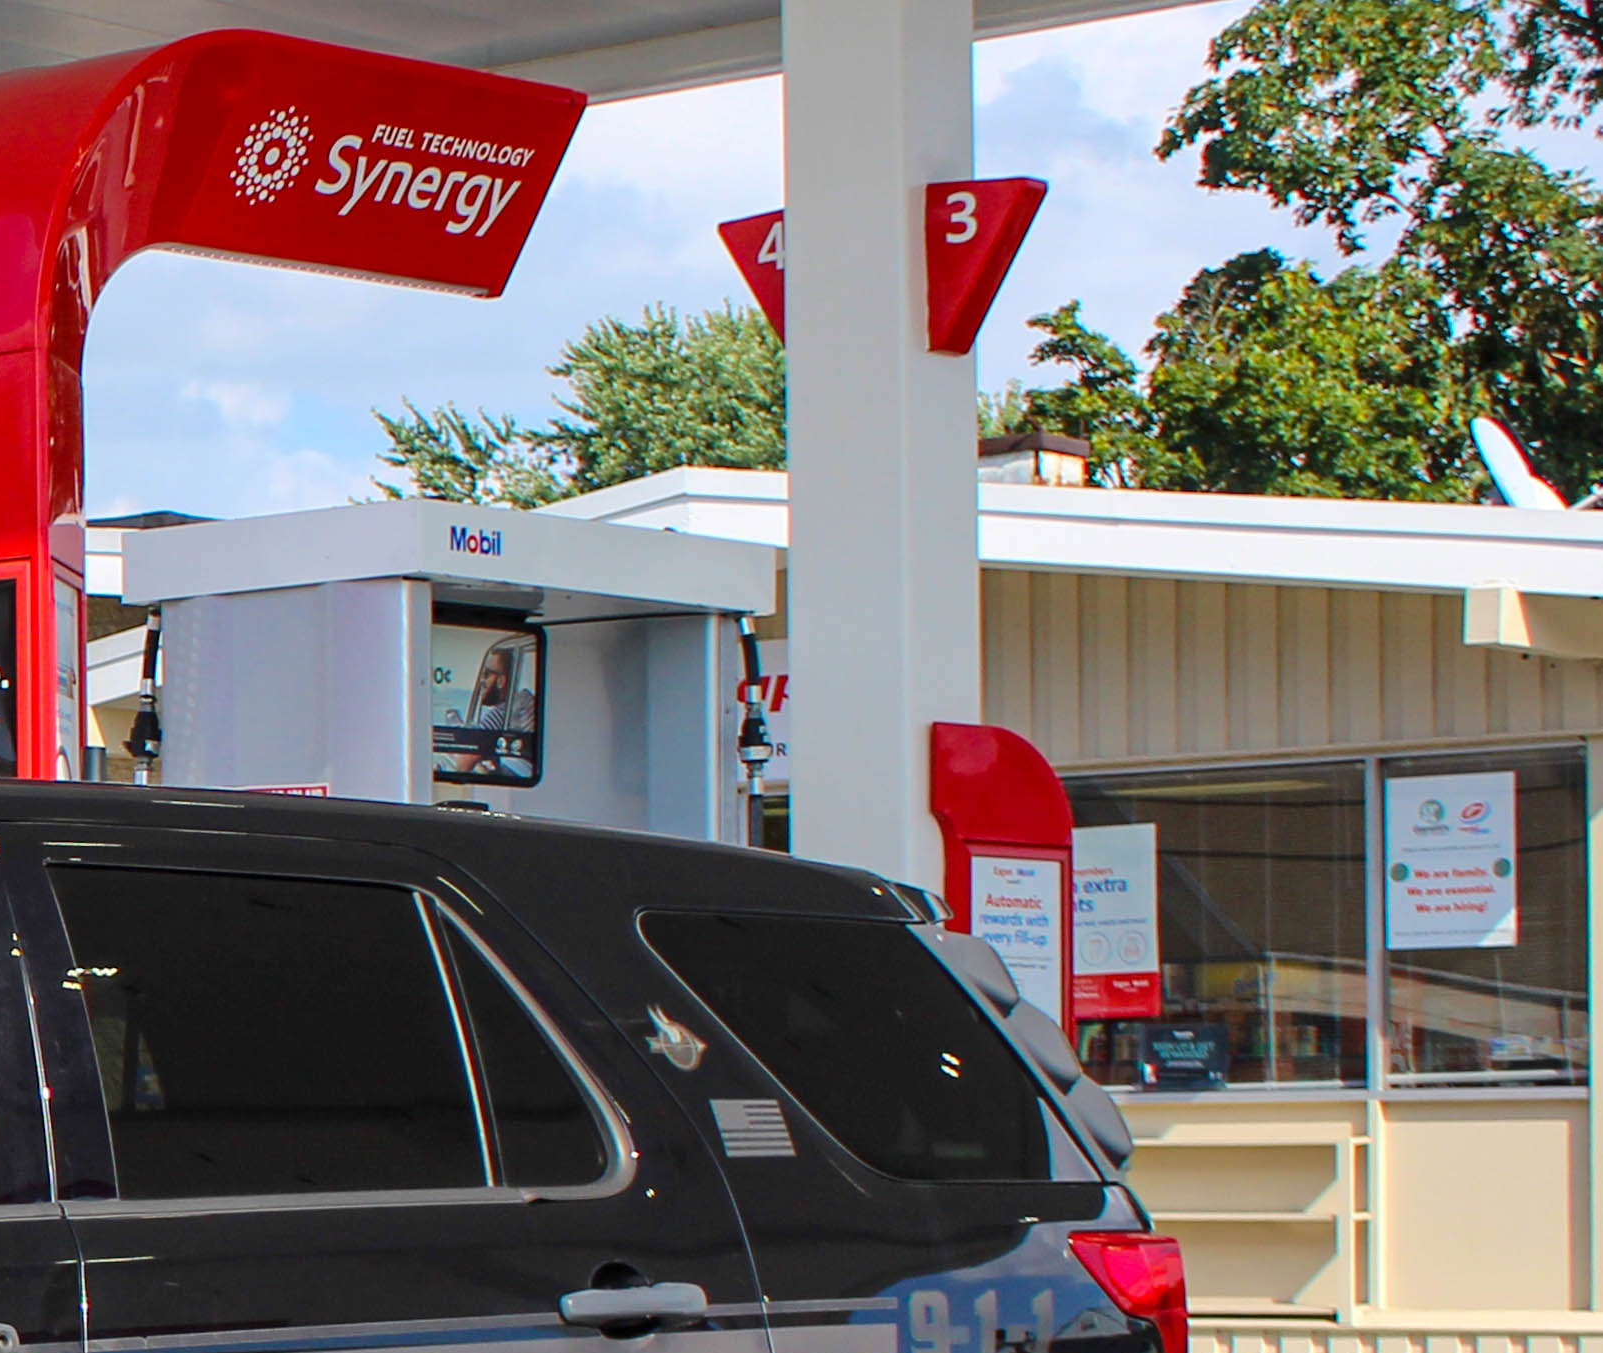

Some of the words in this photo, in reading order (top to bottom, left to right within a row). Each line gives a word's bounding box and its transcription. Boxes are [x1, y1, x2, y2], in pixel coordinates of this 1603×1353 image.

[371, 124, 415, 149] FUEL
[421, 132, 535, 167] TECHNOLOGY
[314, 134, 522, 238] Synergy
[945, 191, 978, 244] 3
[757, 221, 785, 270] 4
[450, 526, 503, 556] Mobil
[985, 893, 1042, 910] Automatic
[1083, 878, 1129, 893] extra
[979, 912, 1023, 927] rewards
[1026, 913, 1049, 927] with
